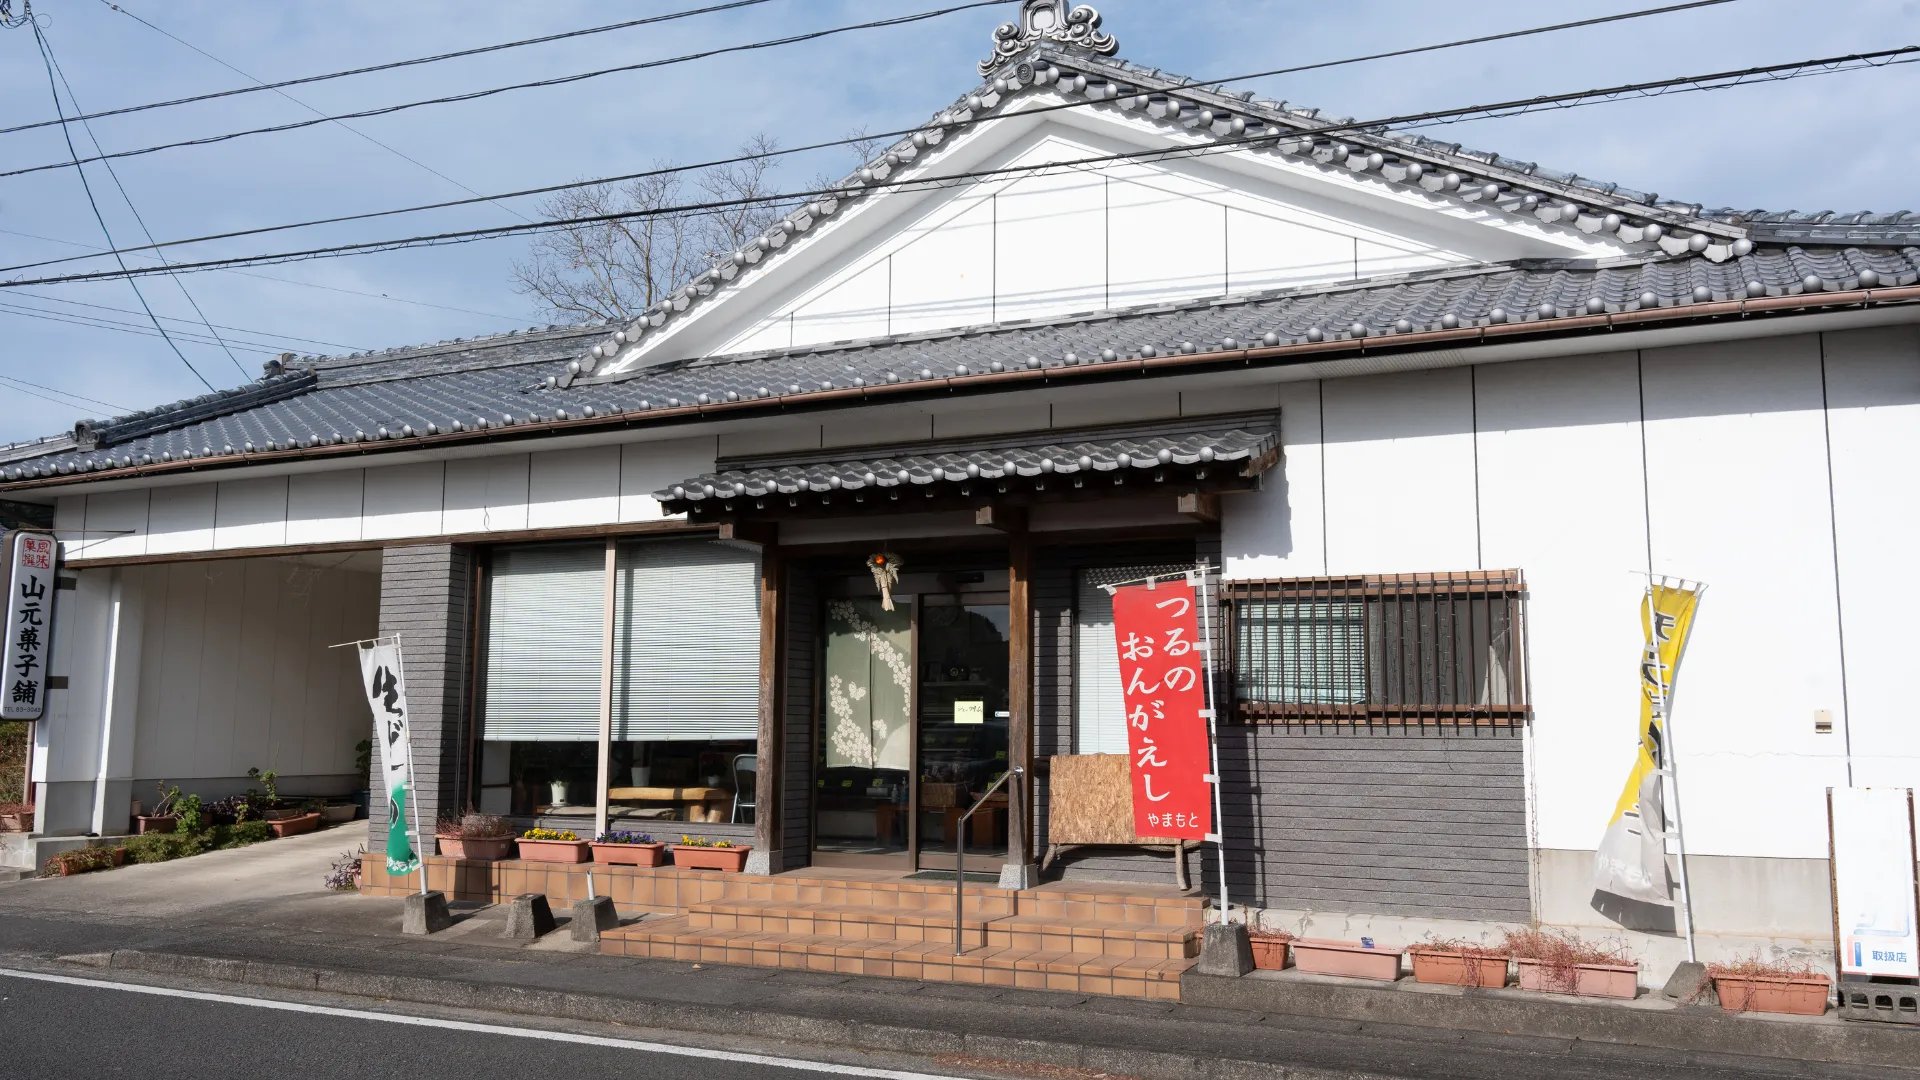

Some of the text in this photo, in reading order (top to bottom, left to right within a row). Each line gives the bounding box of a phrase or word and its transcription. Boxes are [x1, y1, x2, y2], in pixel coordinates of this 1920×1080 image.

[12, 575, 45, 705] 山元菓子舗
[1156, 597, 1196, 692] つるの
[1121, 632, 1170, 801] おんがえし
[1147, 812, 1199, 828] やまもと
[1872, 950, 1907, 963] 取扱店
